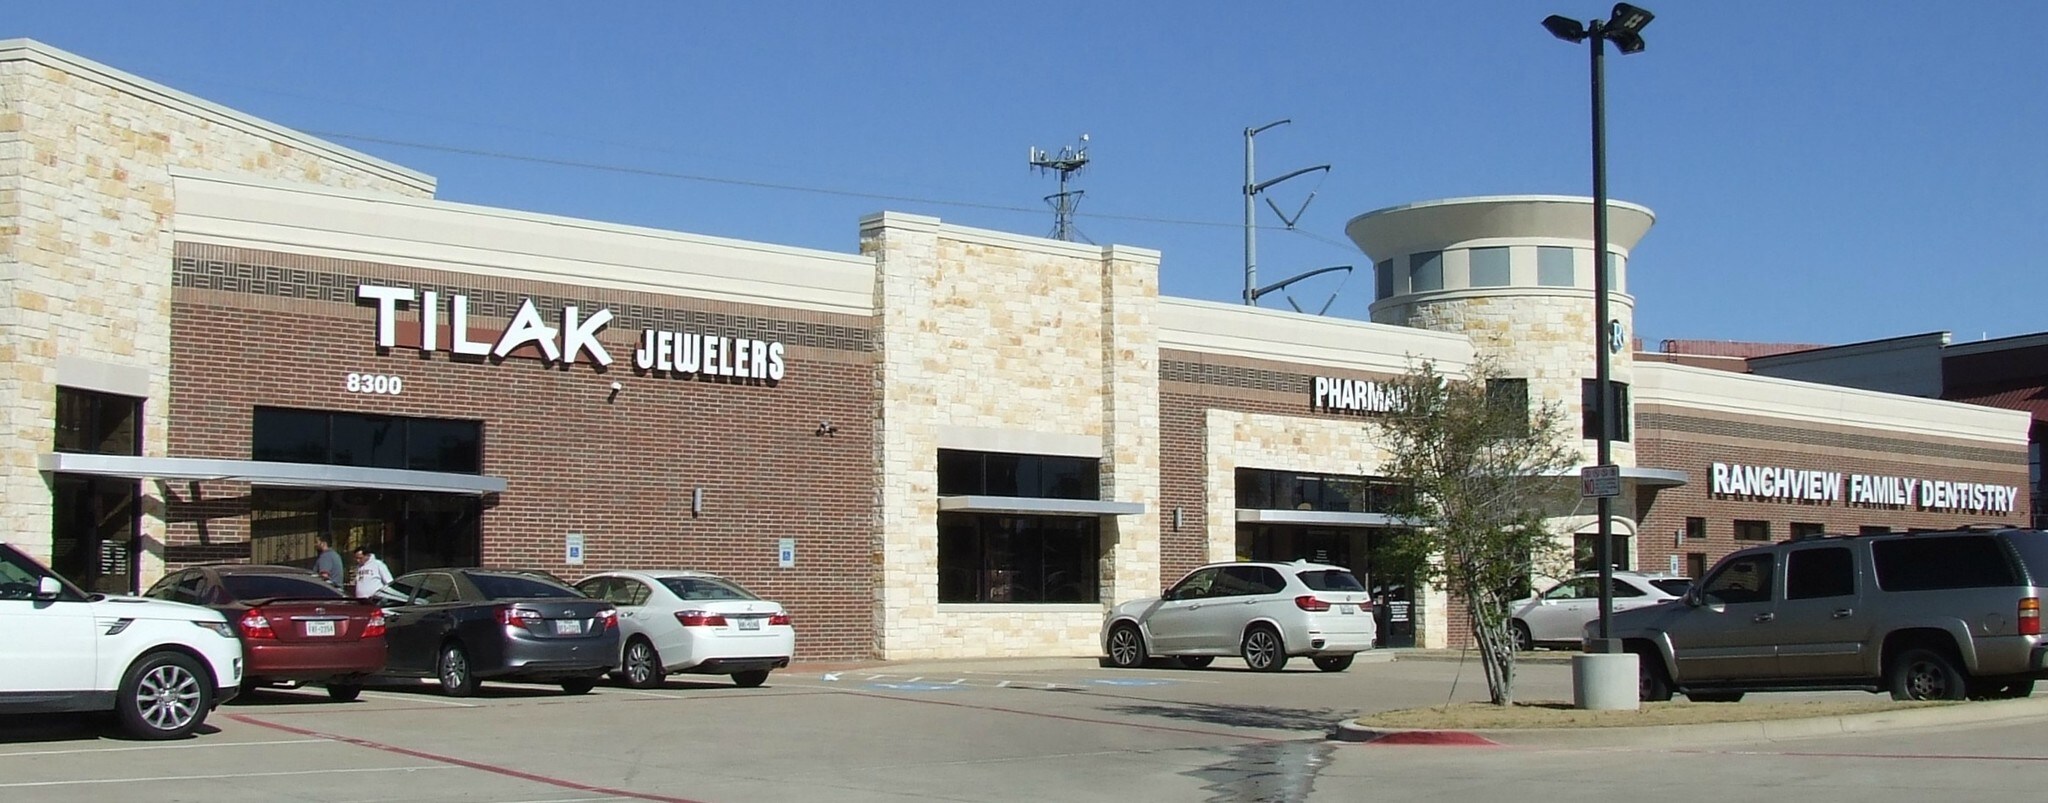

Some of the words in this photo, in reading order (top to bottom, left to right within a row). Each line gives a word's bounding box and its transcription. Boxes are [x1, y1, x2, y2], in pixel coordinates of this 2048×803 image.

[358, 284, 613, 366] TILAK
[636, 329, 785, 381] JEWELERS
[346, 372, 402, 395] 8300
[1584, 479, 1594, 495] NO
[1712, 462, 1841, 501] RANCHVIEW
[1851, 474, 1917, 506] FAMILY
[1921, 480, 2017, 512] DENTISTRY
